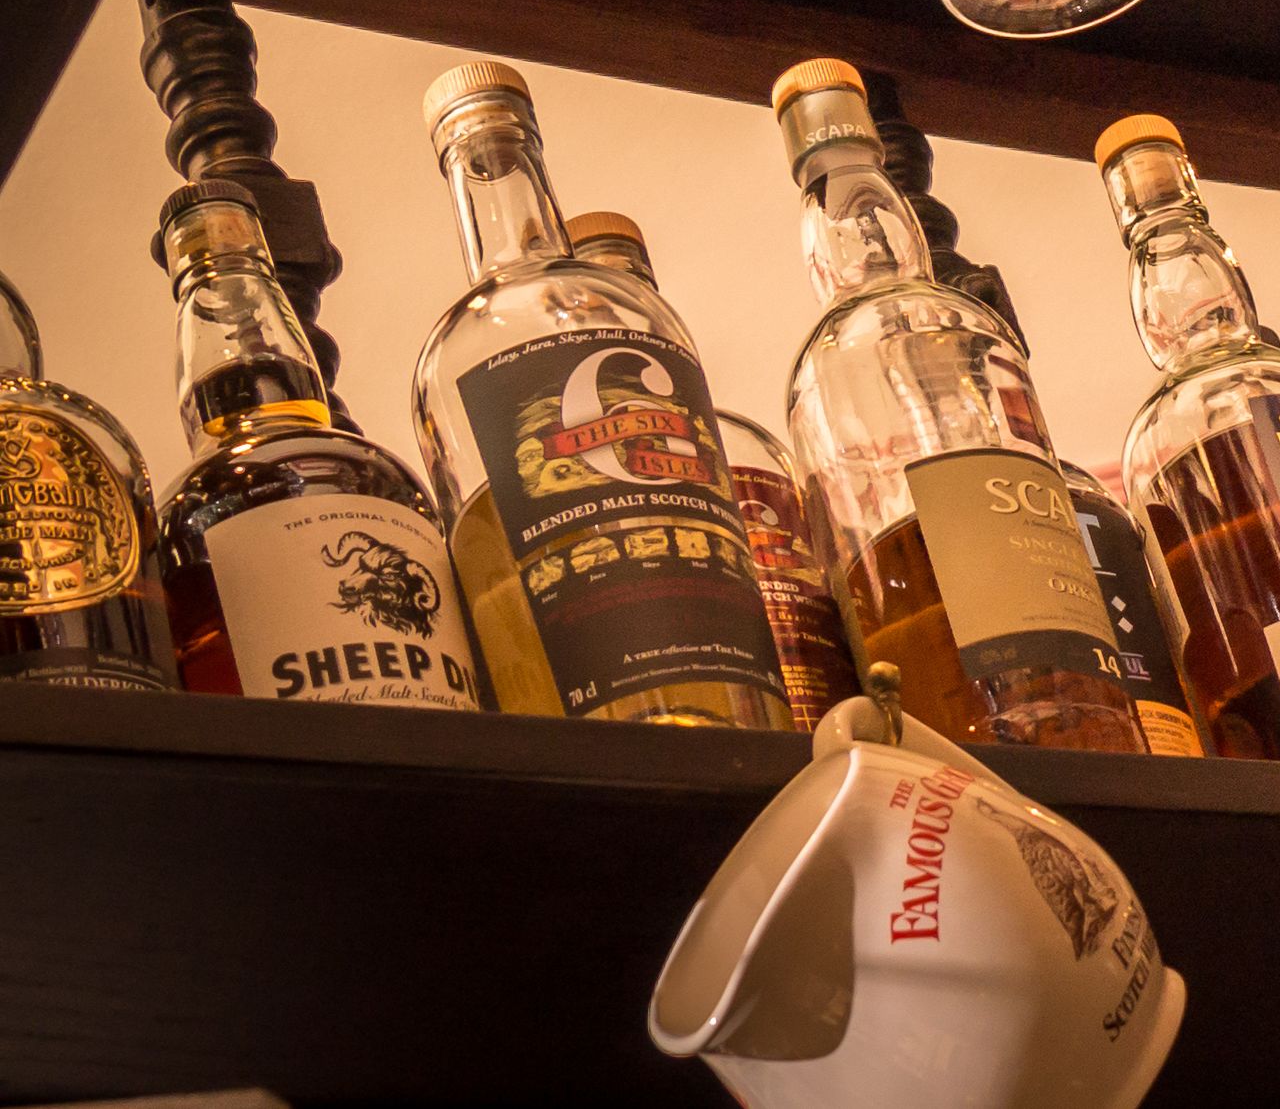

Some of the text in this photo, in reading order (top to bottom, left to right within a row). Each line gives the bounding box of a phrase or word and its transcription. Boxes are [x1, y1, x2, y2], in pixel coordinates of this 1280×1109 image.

[805, 123, 866, 148] SCAPA
[568, 415, 677, 449] THE SIX
[284, 511, 386, 531] THE ORIGINAL
[522, 493, 709, 542] BLENDED MALT SCOTCH
[272, 642, 431, 698] SHEEP
[1093, 648, 1122, 680] 14
[569, 687, 585, 707] 70
[890, 779, 916, 810] THE
[890, 795, 956, 944] FAMOUS
